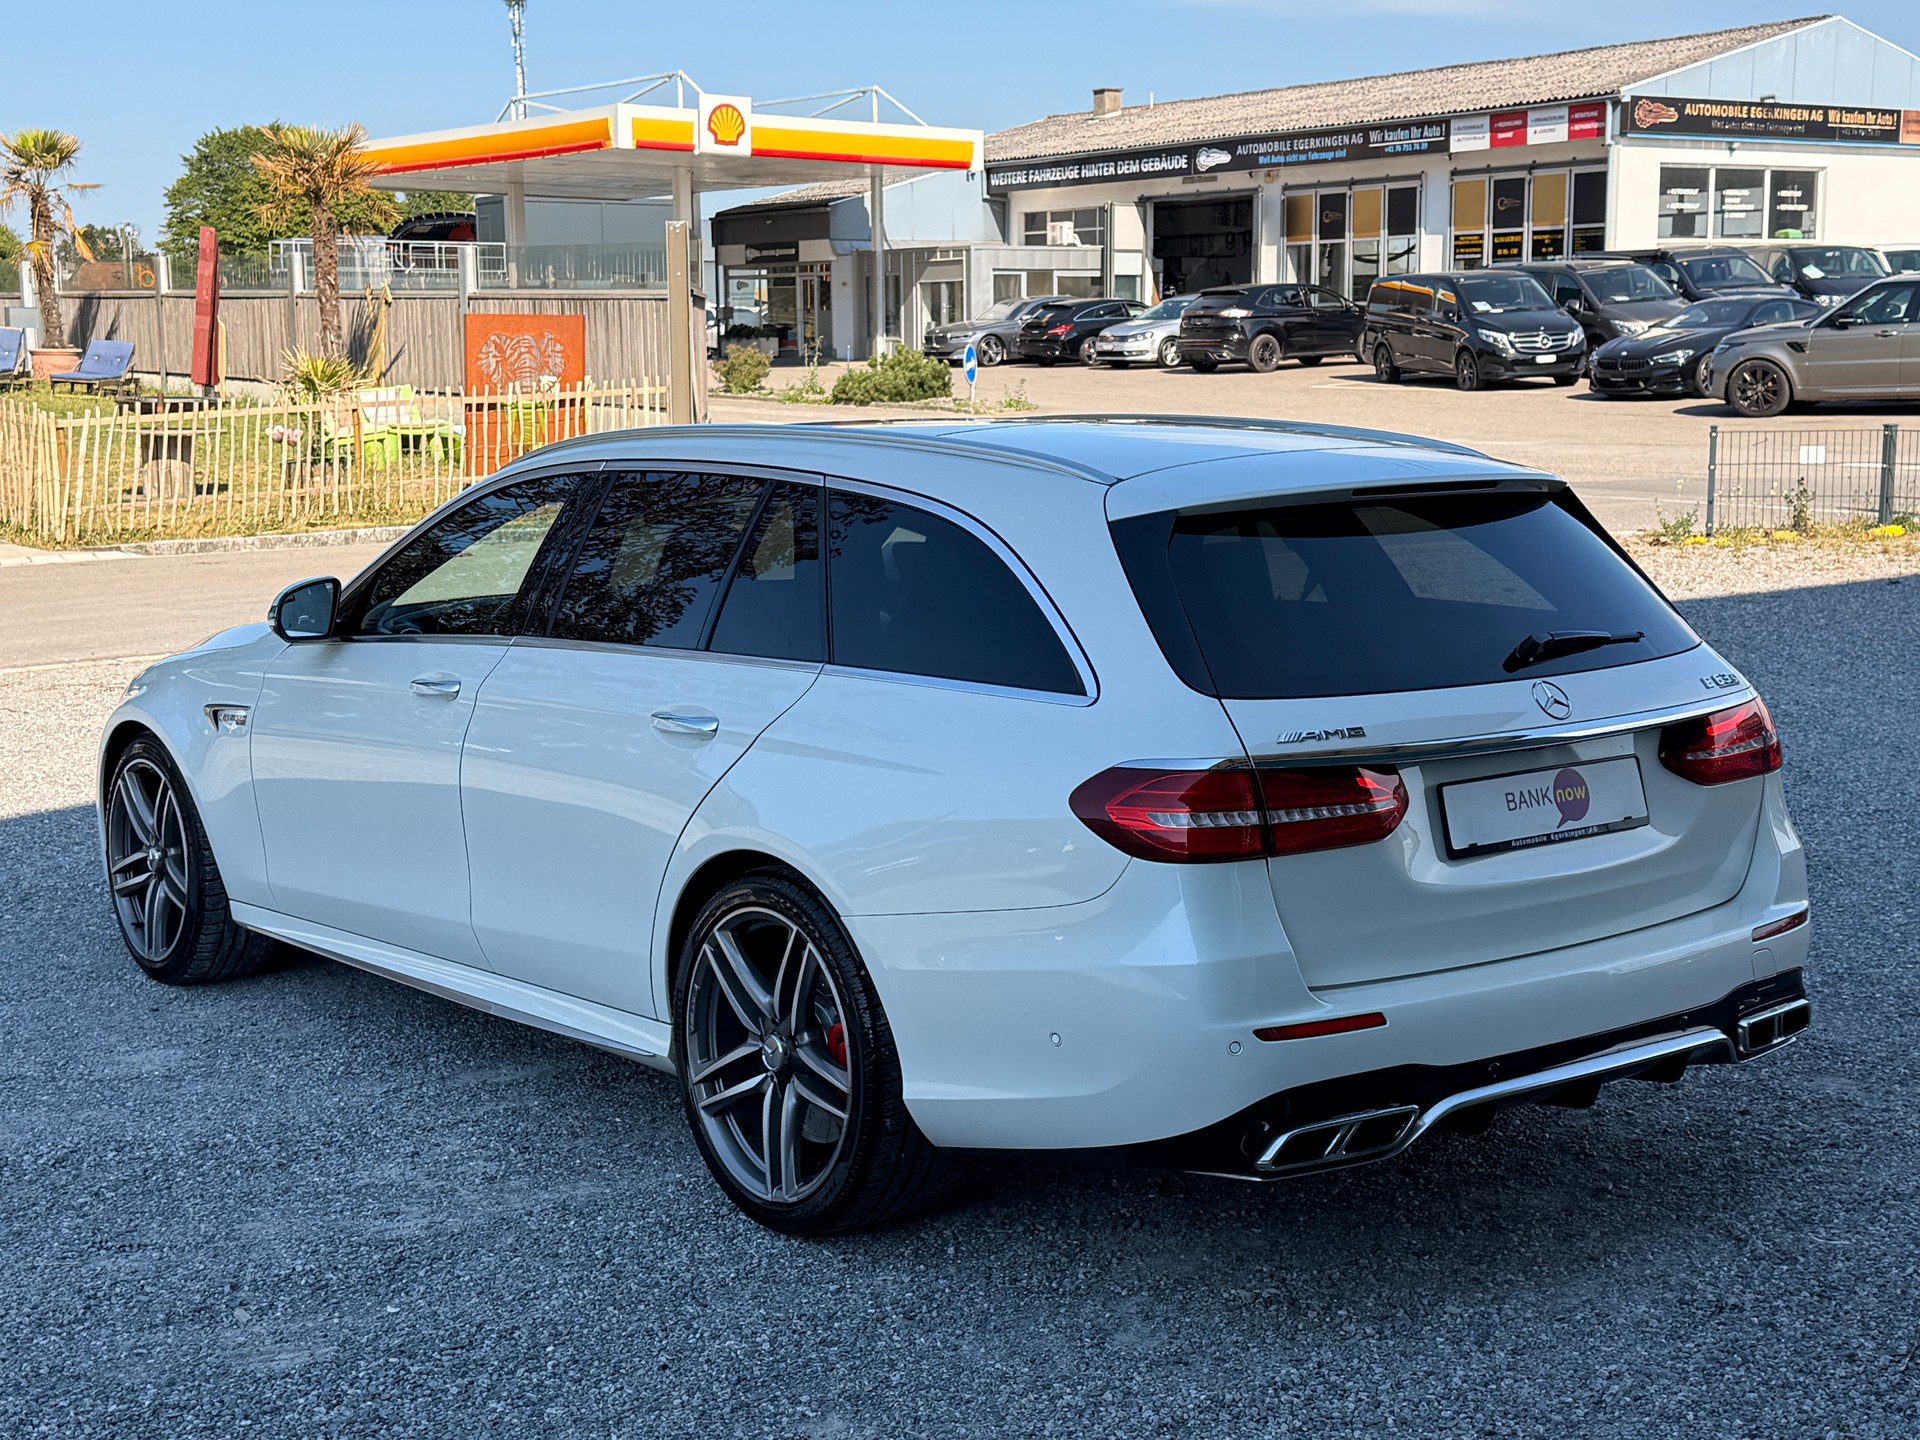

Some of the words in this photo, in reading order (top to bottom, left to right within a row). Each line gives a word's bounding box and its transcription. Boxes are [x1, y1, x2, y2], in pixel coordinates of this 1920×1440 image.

[1684, 104, 1748, 118] AUTOMOBILE
[1750, 106, 1809, 120] EGERKINGEN
[1810, 109, 1824, 122] AG
[1876, 112, 1892, 126] Auto
[1369, 130, 1383, 143] Wir
[1384, 128, 1410, 141] kaufen
[1410, 126, 1422, 139] Ihr
[1422, 124, 1440, 138] Auto
[1236, 140, 1291, 155] AUTOMOBILE
[1294, 134, 1349, 150] EGERKINGEN
[1350, 133, 1364, 145] AG
[990, 171, 1027, 186] WEITERE
[1028, 166, 1079, 183] FAHRZEUGE
[1081, 162, 1115, 178] HINTER
[1117, 160, 1139, 176] DEM
[1141, 154, 1188, 172] GEBÄUDE
[1297, 726, 1366, 741] AMG
[1505, 787, 1553, 812] BANK
[1556, 785, 1586, 804] now
[1512, 836, 1547, 847] Automobile
